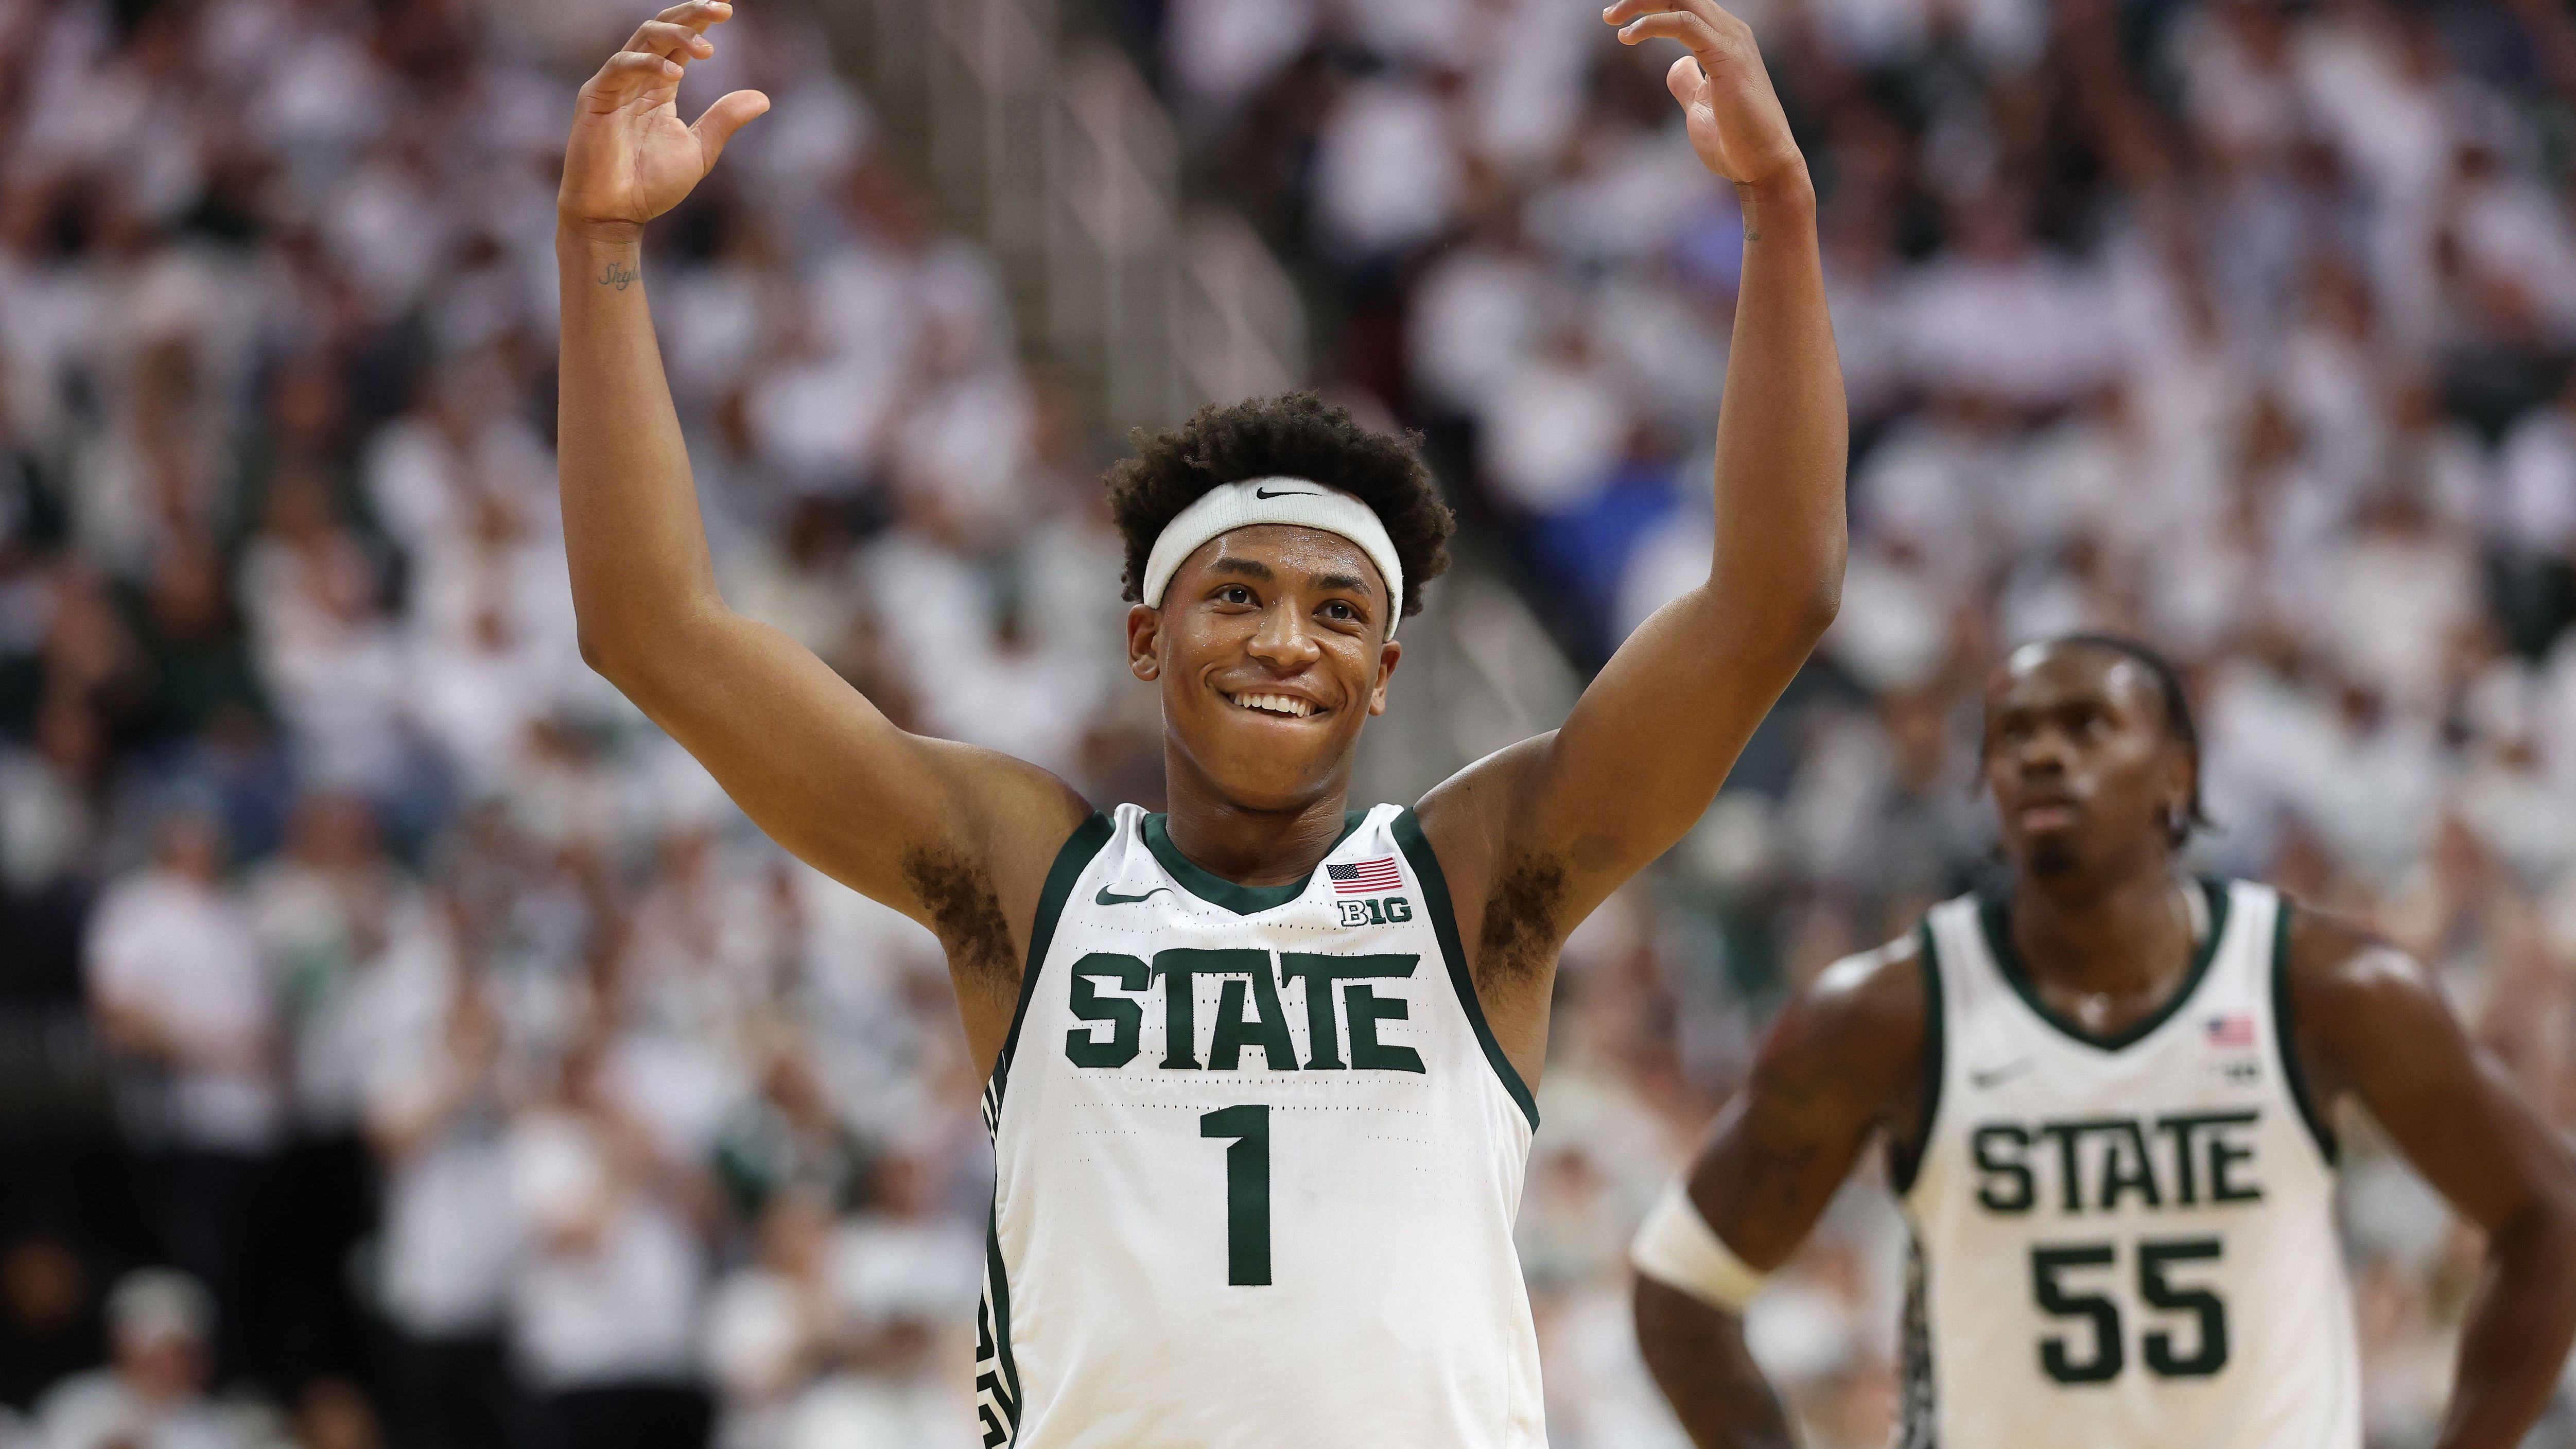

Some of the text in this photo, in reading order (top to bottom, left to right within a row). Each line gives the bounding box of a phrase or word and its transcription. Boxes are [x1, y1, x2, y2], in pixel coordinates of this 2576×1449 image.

[1065, 948, 1426, 1075] STATE
[1200, 1104, 1273, 1287] 1
[1971, 1109, 2264, 1216] STATE
[2028, 1237, 2230, 1388] 55
